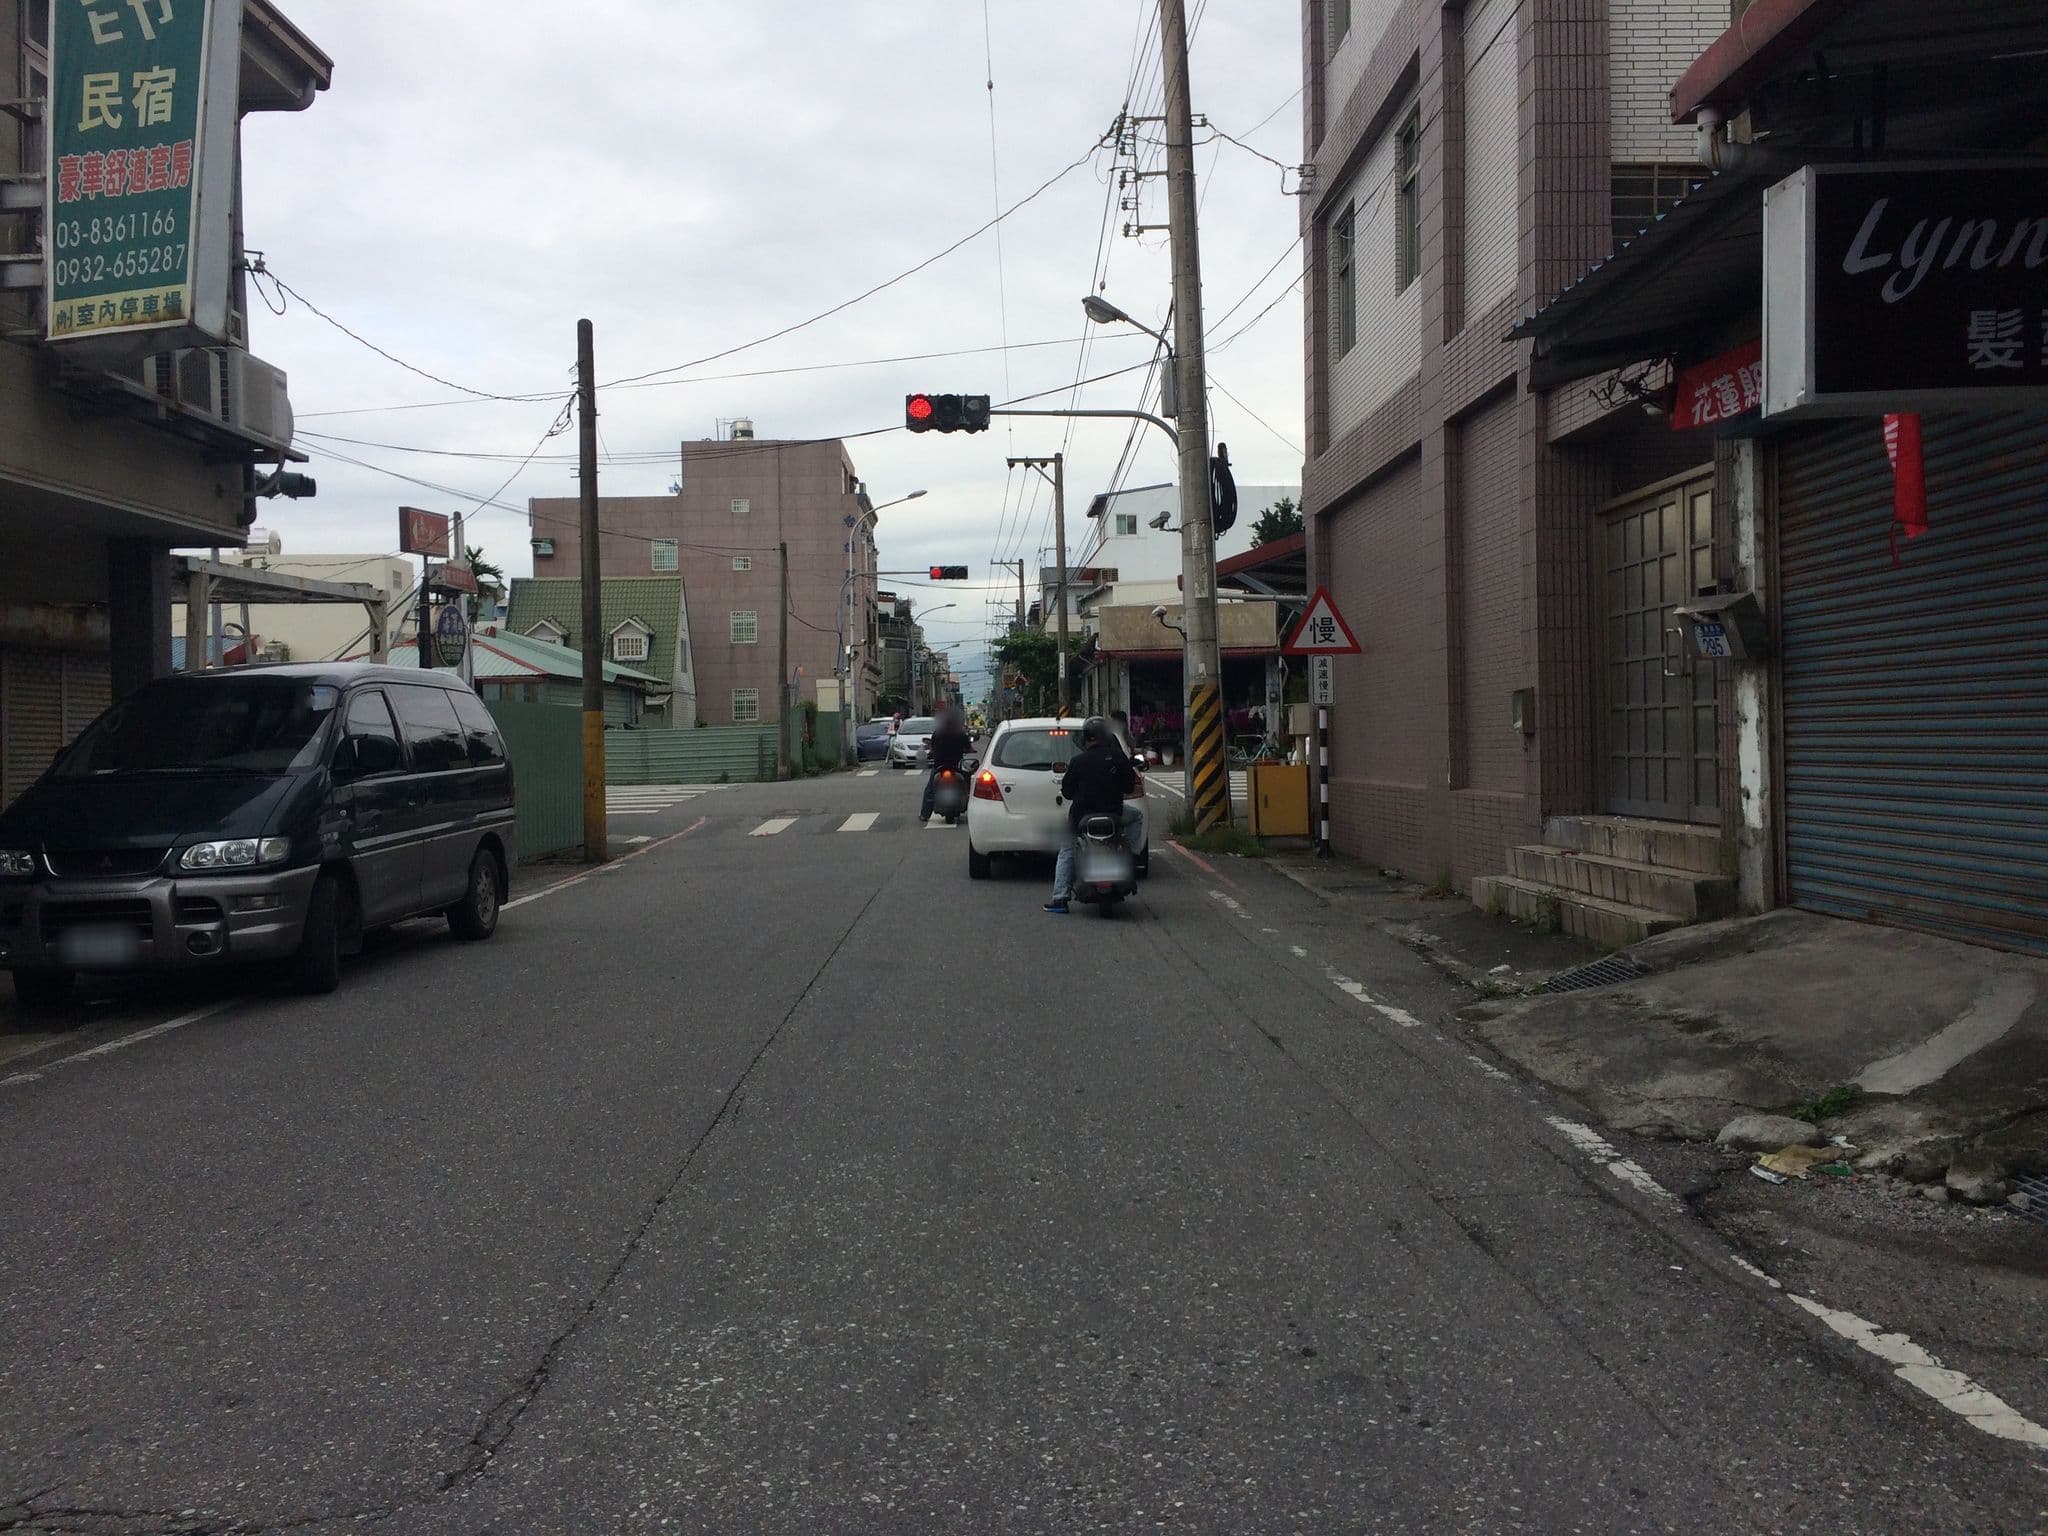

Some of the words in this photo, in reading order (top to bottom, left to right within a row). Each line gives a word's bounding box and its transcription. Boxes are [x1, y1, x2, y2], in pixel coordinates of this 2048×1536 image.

[78, 66, 176, 132] 民宿
[59, 139, 192, 203] 豪華舒適套房
[56, 208, 175, 249] 03-8361166
[56, 244, 186, 286] 0932-655287
[1967, 308, 2048, 369] 髮
[1309, 616, 1336, 644] 慢
